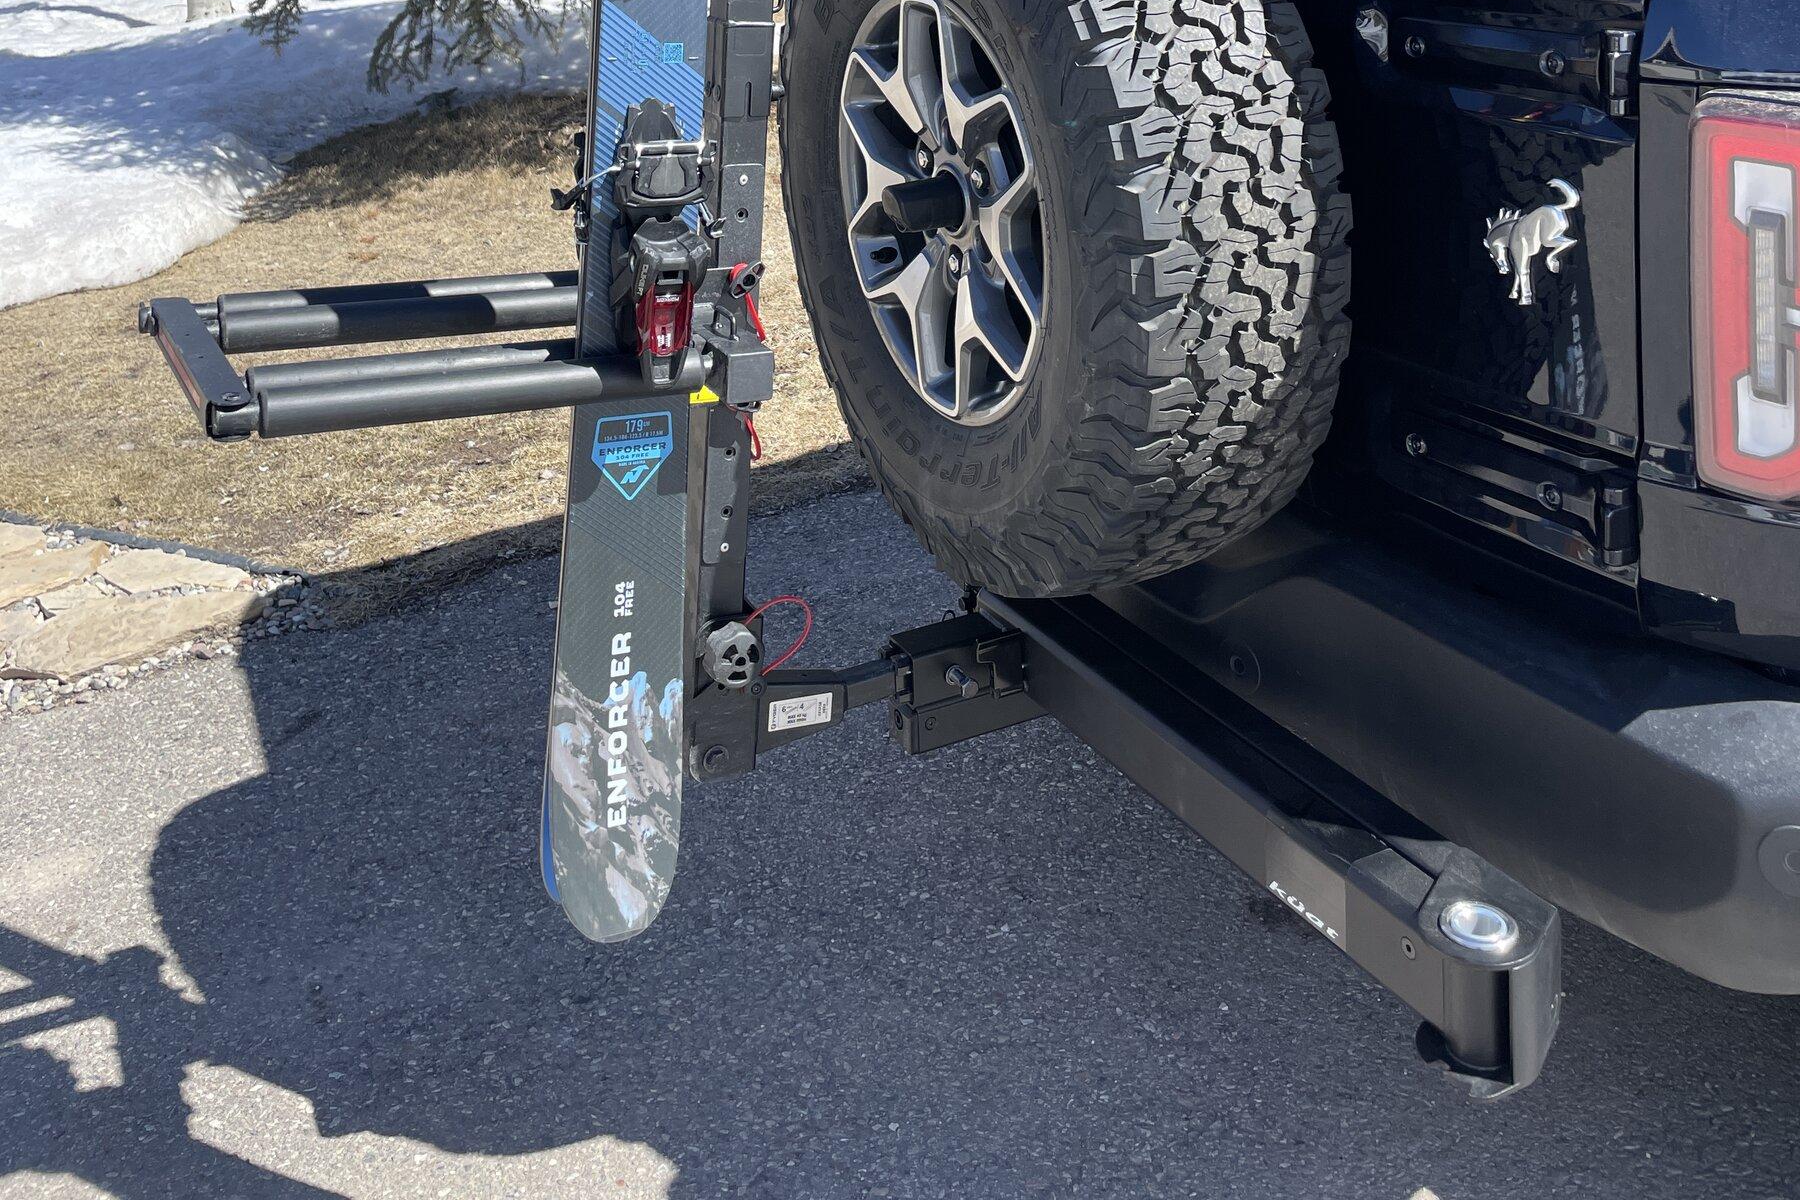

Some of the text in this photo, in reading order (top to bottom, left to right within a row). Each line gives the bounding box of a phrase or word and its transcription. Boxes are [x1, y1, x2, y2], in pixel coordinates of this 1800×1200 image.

[599, 441, 667, 456] ENFORCER
[624, 580, 635, 617] FREE
[607, 581, 632, 828] ENFORCER 104
